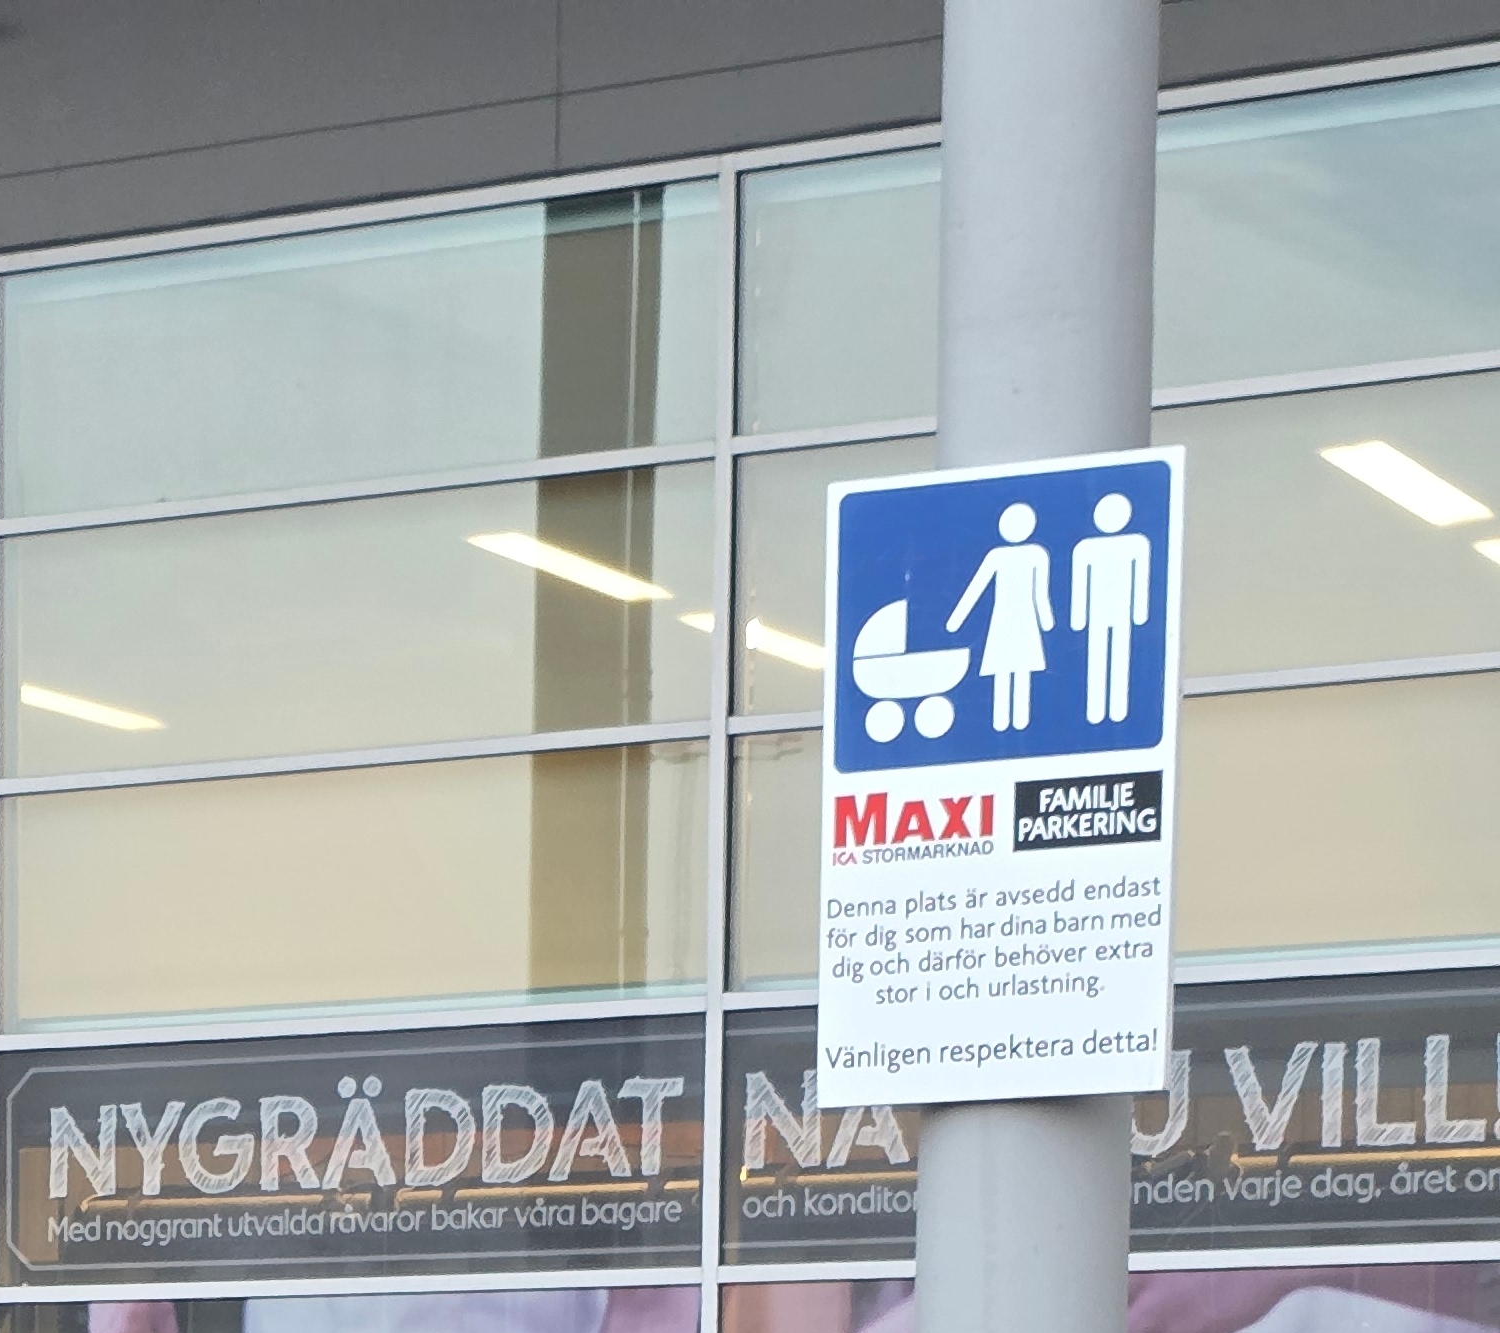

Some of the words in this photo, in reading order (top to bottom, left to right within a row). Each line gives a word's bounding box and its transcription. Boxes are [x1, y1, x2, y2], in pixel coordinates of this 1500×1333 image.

[834, 792, 994, 848] MAXI
[1039, 781, 1135, 814] FAMILJE
[1017, 808, 1157, 842] PARKERING
[832, 851, 858, 867] ICA
[862, 839, 994, 866] STORMARKNAD
[827, 898, 896, 919] Denna
[905, 891, 956, 919] plats
[965, 888, 988, 909] är
[995, 879, 1075, 907] avsedd
[1084, 876, 1161, 900] endast
[826, 926, 857, 948] för
[865, 924, 897, 952] dig
[905, 924, 951, 944] som
[960, 917, 995, 940] har
[1000, 914, 1047, 937] dina
[1053, 910, 1104, 934] barn
[1110, 904, 1162, 927] med
[832, 956, 864, 984] dig
[870, 952, 910, 976] och
[918, 948, 987, 972] därför
[994, 943, 1087, 968] behöver
[1095, 939, 1153, 961] extra
[876, 983, 918, 1005] stor
[925, 981, 931, 1001] i
[938, 976, 979, 1000] och
[988, 972, 1106, 998] urlastning.
[826, 1041, 931, 1074] Vänligen
[939, 1033, 1074, 1068] respektera
[1082, 1028, 1158, 1055] detta!
[49, 1075, 685, 1199] NYGRÄDDAT
[1224, 1033, 1500, 1151] VILL
[48, 1215, 100, 1243] Med
[106, 1210, 222, 1247] noggrant
[228, 1207, 324, 1237] utvalda
[330, 1203, 425, 1233] råvaror
[432, 1203, 508, 1231] bakar
[514, 1197, 575, 1228] våra
[581, 1198, 682, 1231] bagare
[742, 1189, 796, 1219] och
[1133, 1173, 1214, 1205] nden
[1223, 1170, 1302, 1207] varje
[1310, 1167, 1382, 1203] dag,
[1389, 1162, 1457, 1195] året
